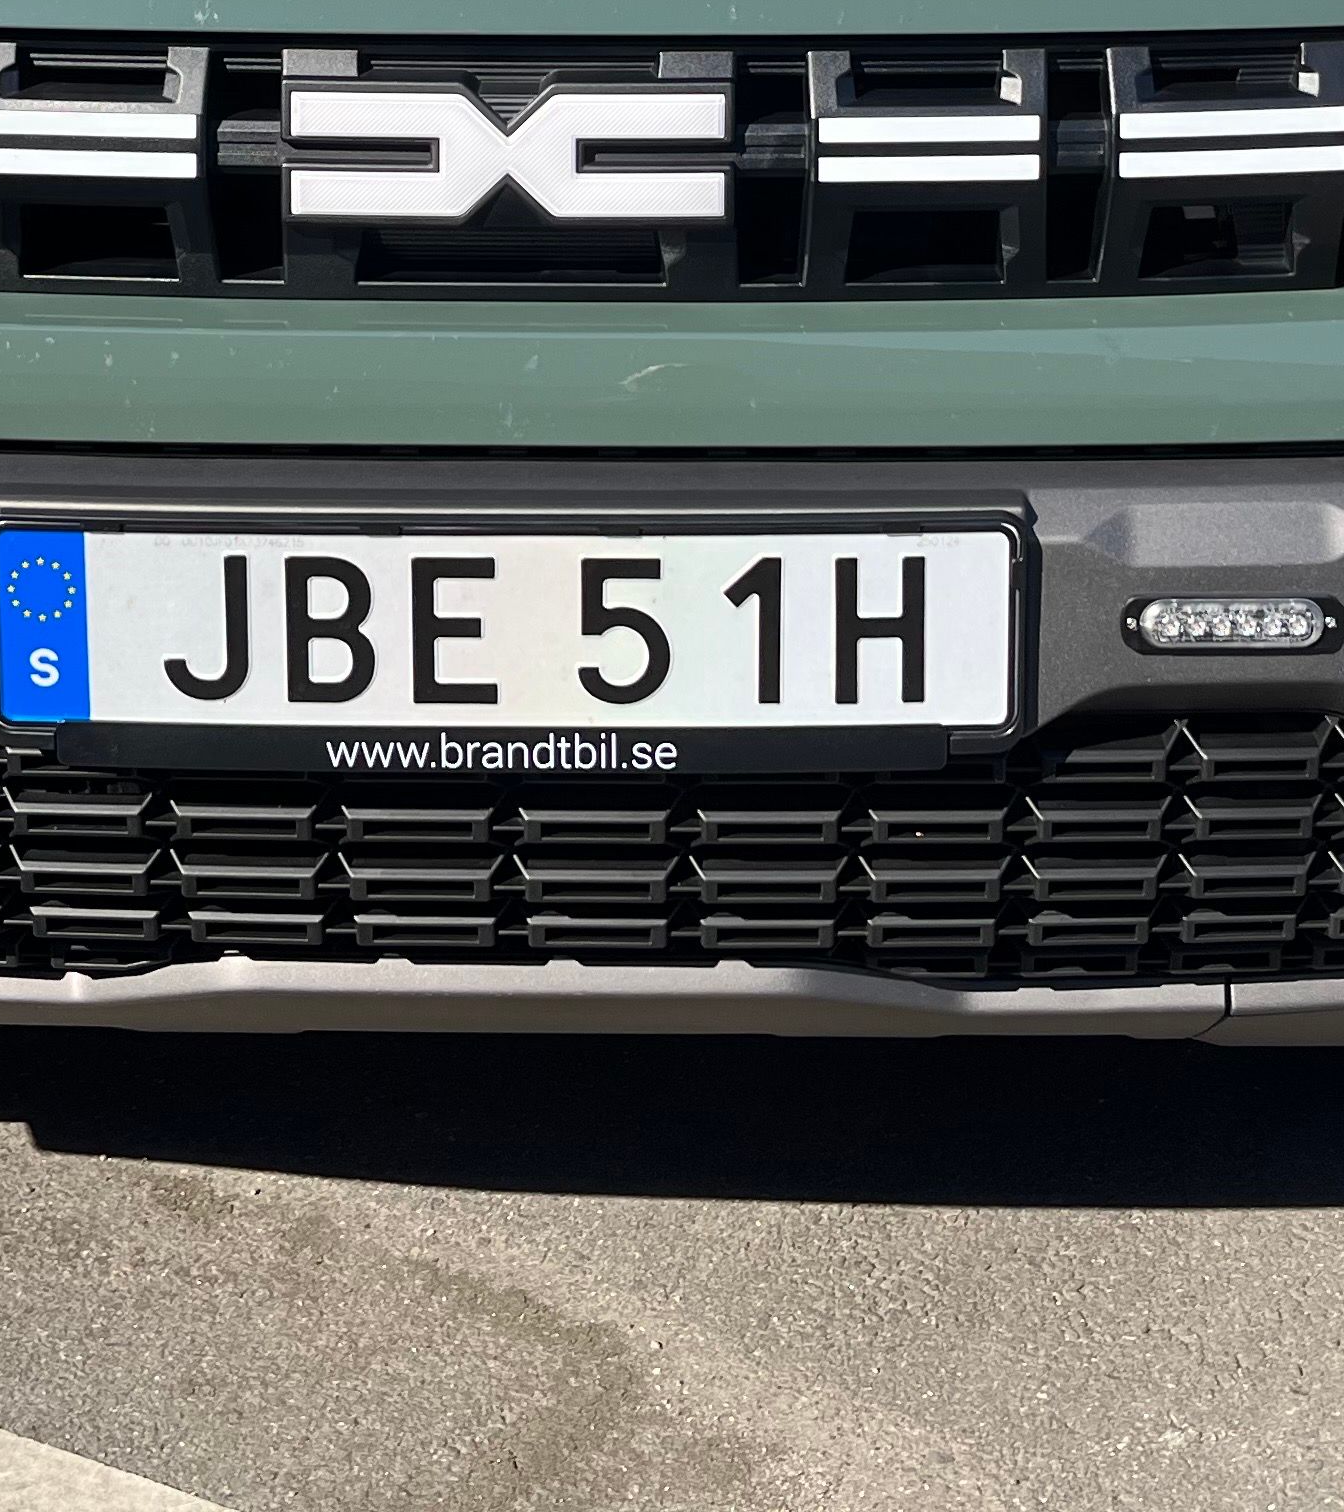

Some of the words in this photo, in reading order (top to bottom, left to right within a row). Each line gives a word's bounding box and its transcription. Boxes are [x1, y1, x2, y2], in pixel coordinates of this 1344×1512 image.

[163, 554, 500, 705] JBE
[576, 556, 928, 705] 51H
[29, 648, 60, 687] S
[325, 732, 678, 770] www.brandtbil.se
